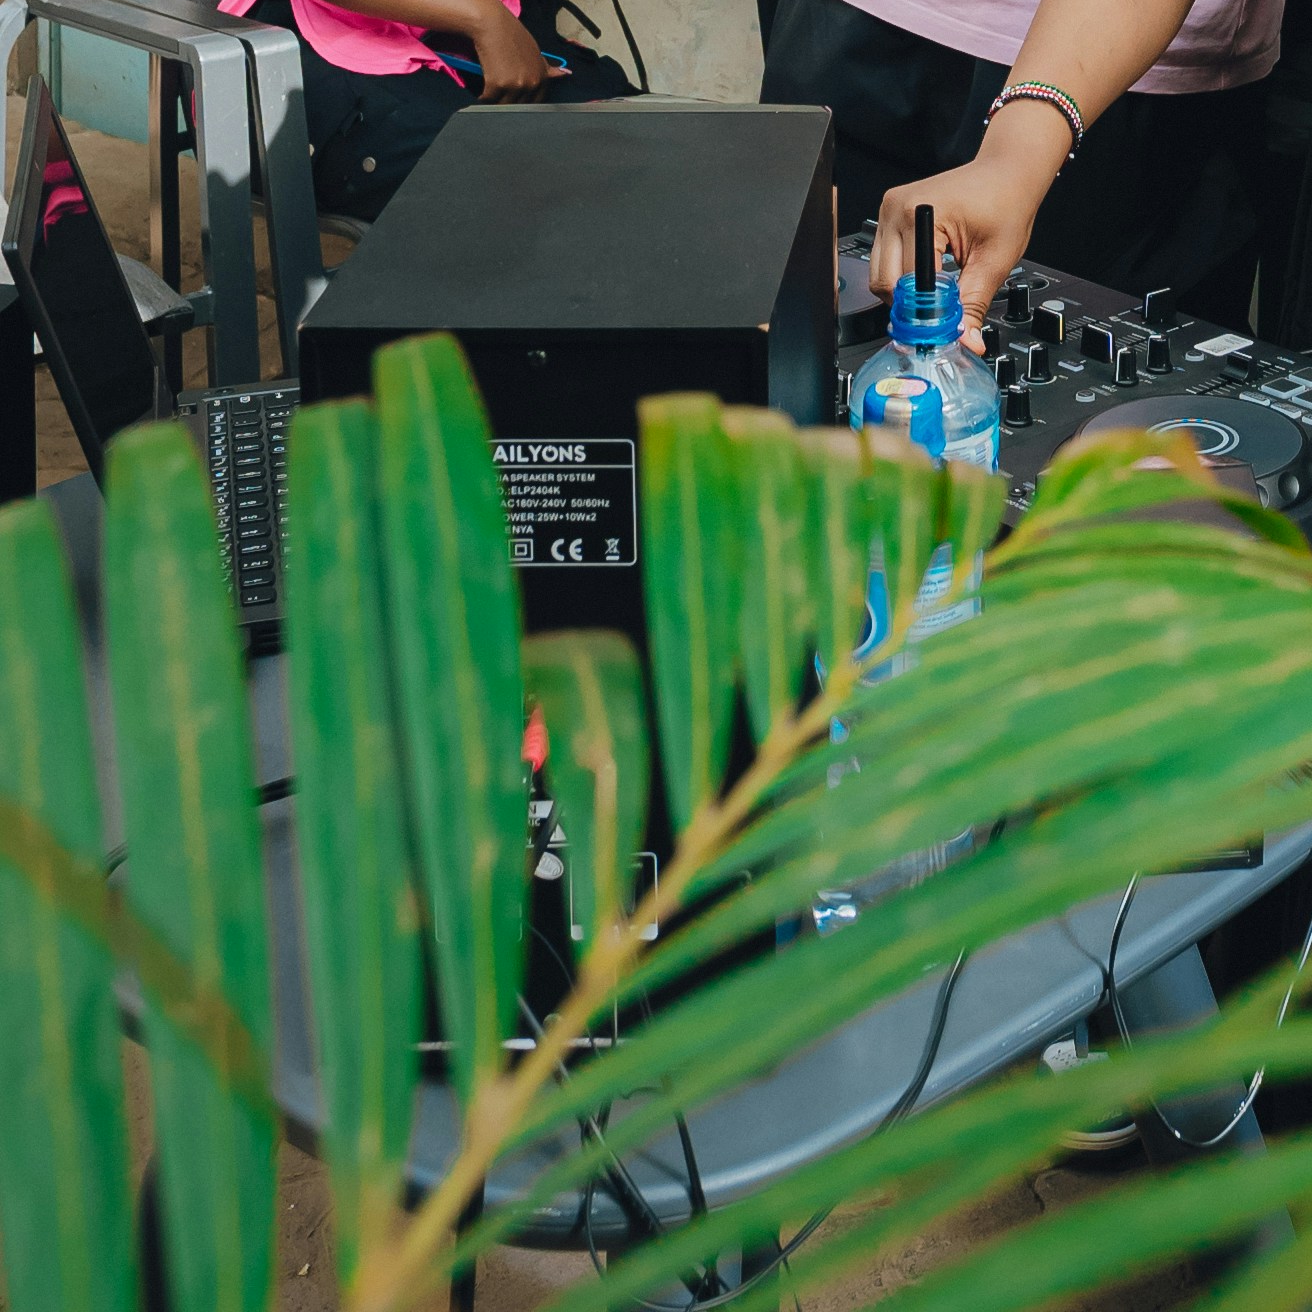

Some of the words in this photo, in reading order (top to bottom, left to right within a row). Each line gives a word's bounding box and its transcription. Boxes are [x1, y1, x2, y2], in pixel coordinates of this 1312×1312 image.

[492, 444, 587, 463] AILYONS
[510, 473, 555, 482] SPEAKER
[556, 473, 596, 482] SYSTEM
